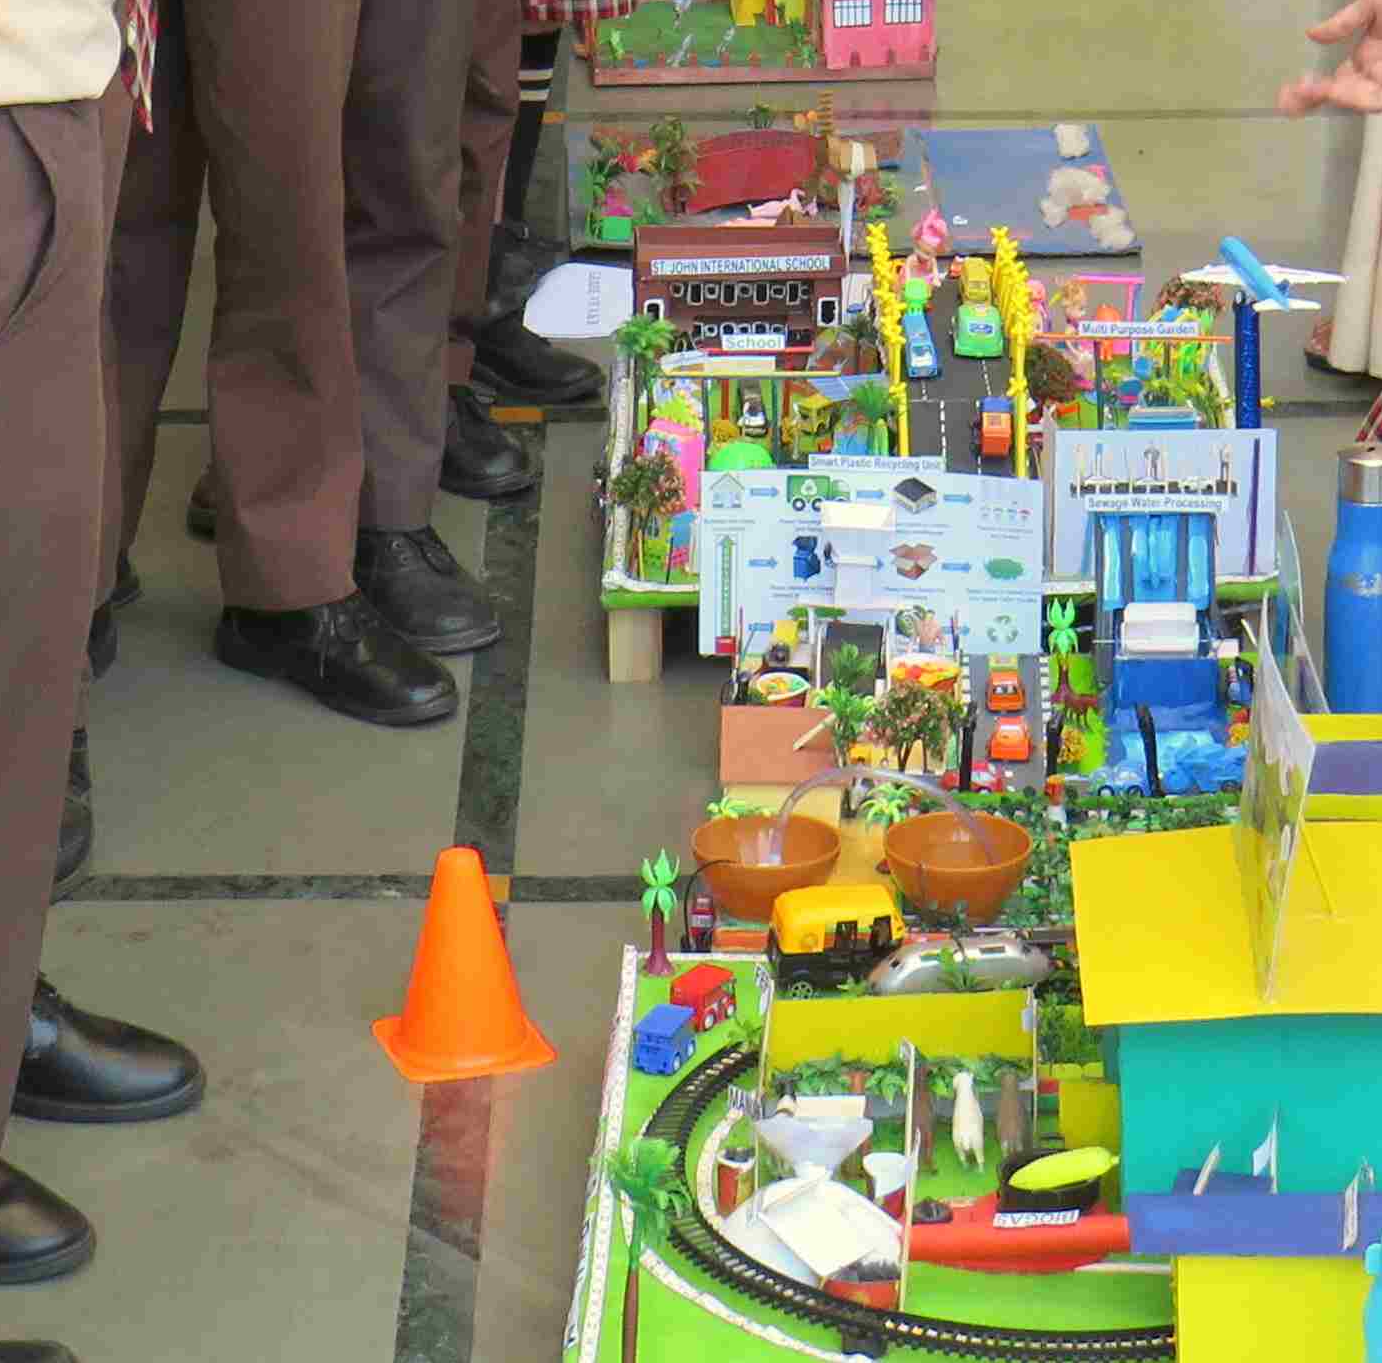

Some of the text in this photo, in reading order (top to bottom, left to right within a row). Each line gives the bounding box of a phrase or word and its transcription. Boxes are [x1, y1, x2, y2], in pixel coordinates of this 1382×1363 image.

[670, 259, 699, 273] JOHN
[700, 257, 783, 273] INTERNATIONAL
[784, 255, 830, 271] SCHOOL
[725, 334, 783, 350] School
